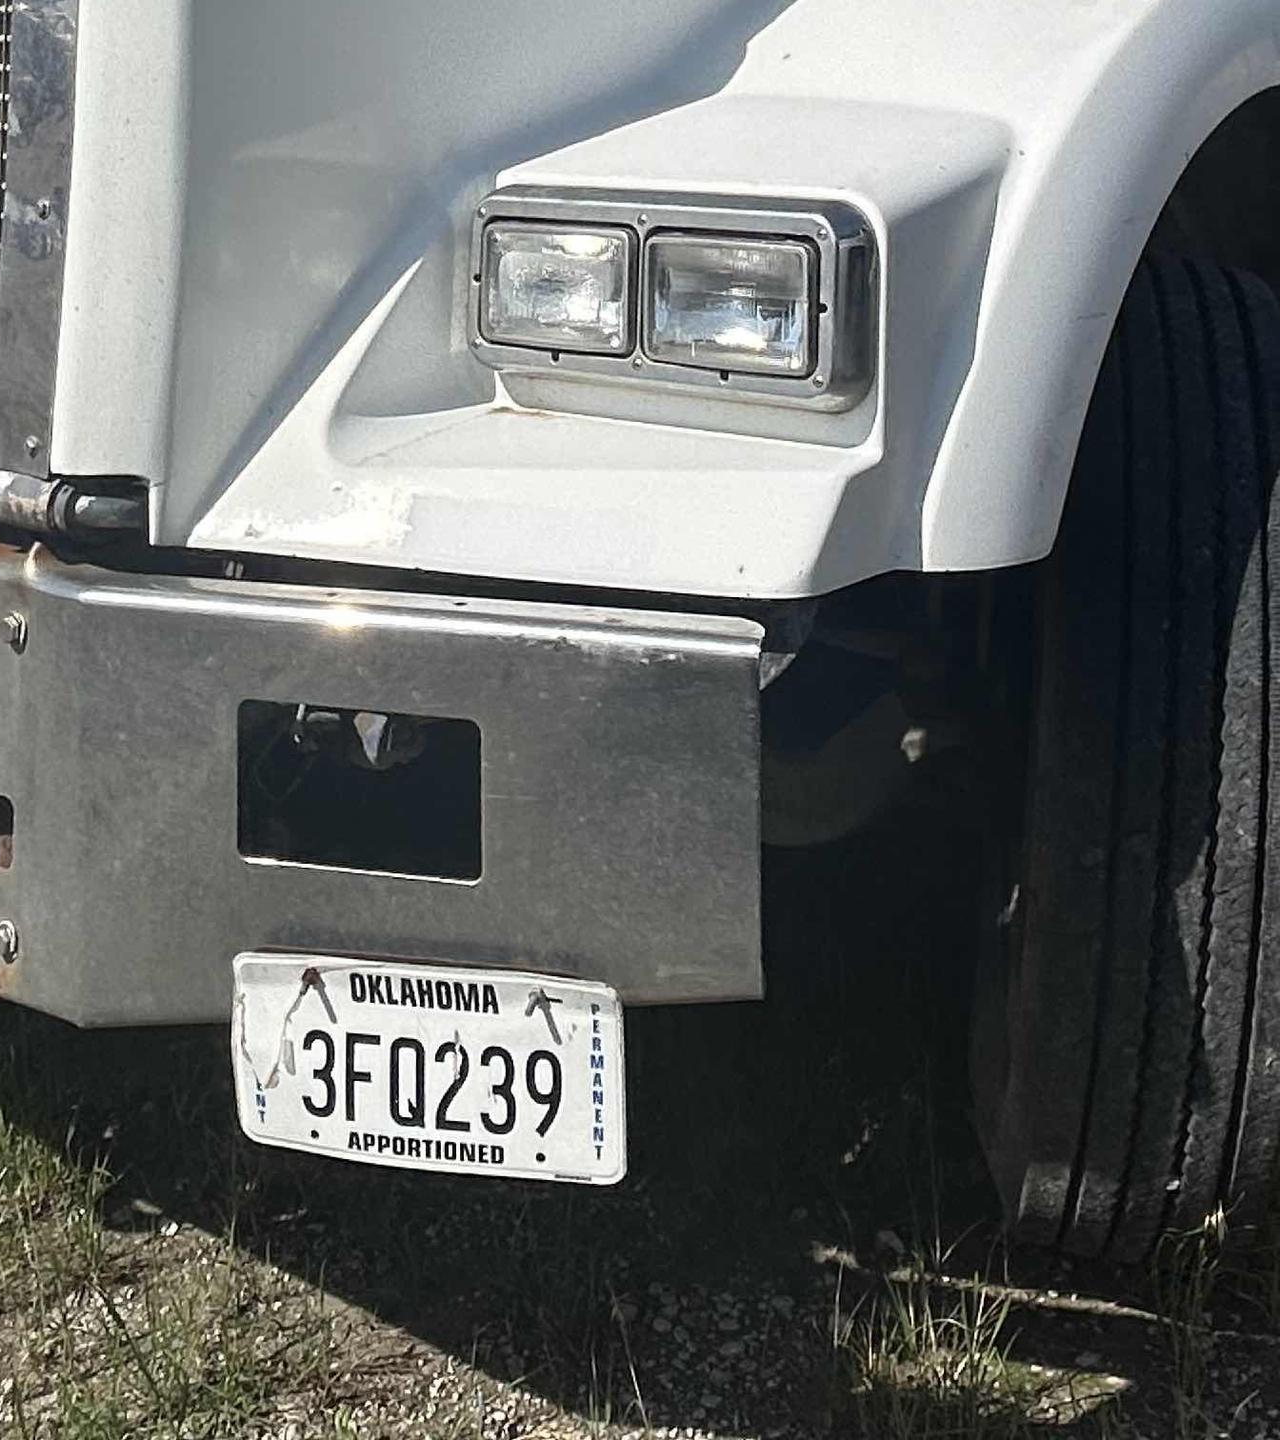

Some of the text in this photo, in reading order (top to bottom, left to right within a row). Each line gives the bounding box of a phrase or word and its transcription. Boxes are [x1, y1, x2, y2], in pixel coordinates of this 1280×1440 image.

[349, 972, 499, 1015] OKLAHOMA
[302, 1029, 562, 1137] 3FQ239
[590, 1003, 604, 1160] PERMANENT
[348, 1131, 504, 1164] APPORTIONED
